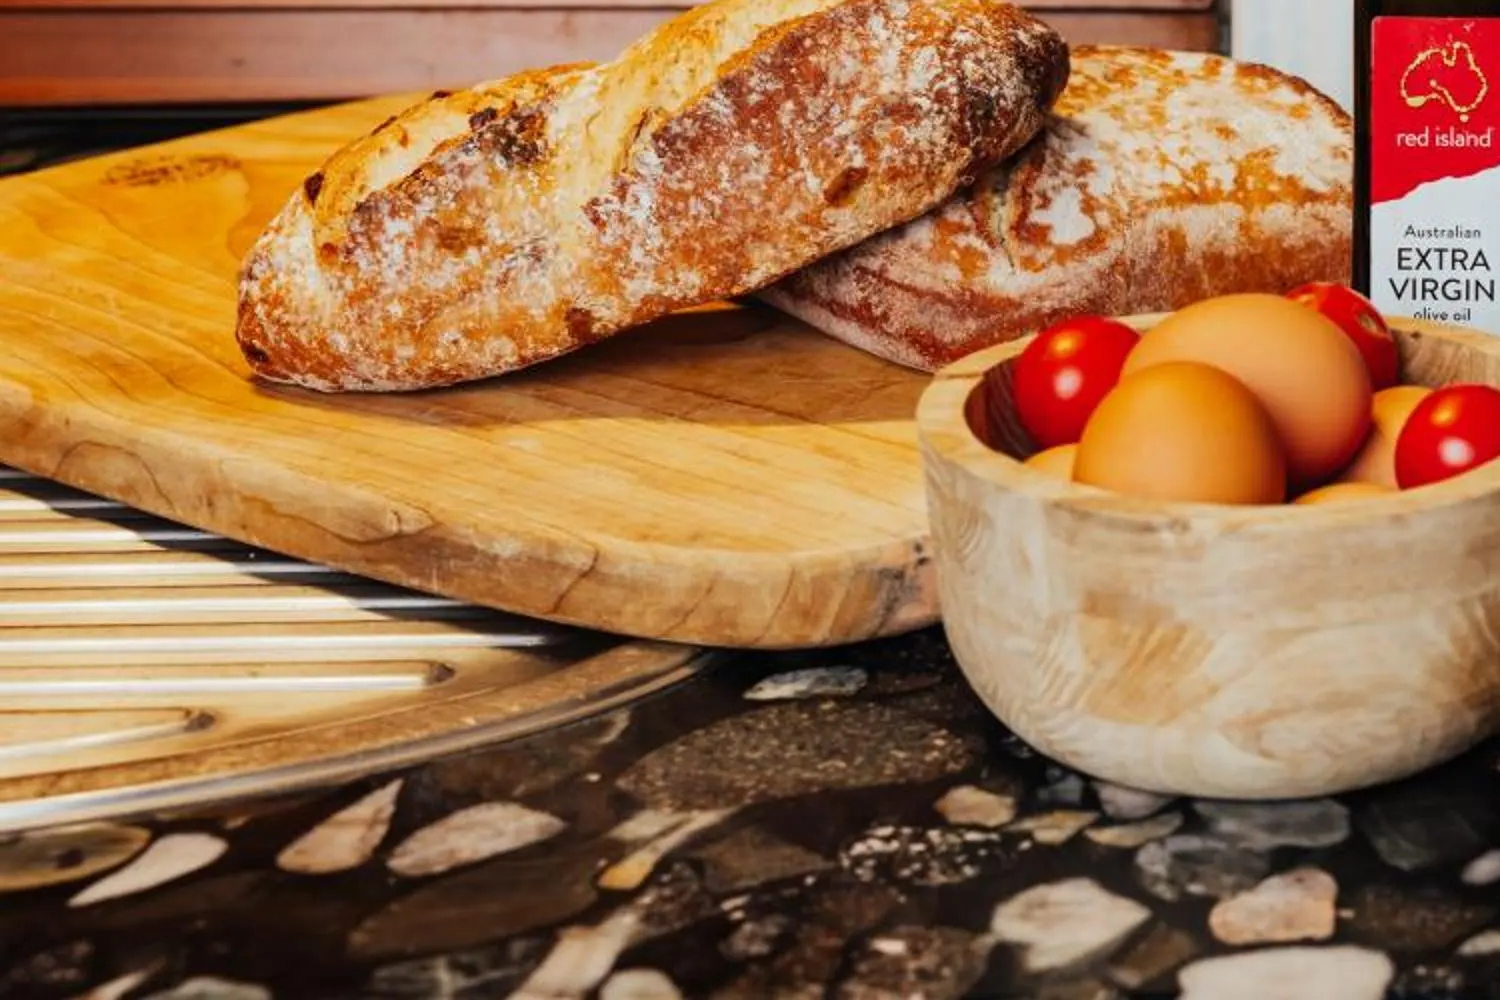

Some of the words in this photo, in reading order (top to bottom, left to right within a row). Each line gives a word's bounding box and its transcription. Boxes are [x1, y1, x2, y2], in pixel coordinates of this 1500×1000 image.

[1396, 125, 1429, 147] red
[1435, 125, 1492, 147] island
[1404, 224, 1481, 238] Australian
[1398, 247, 1491, 271] EXTRA
[1388, 278, 1495, 301] VIRGIN
[1453, 307, 1471, 321] oil
